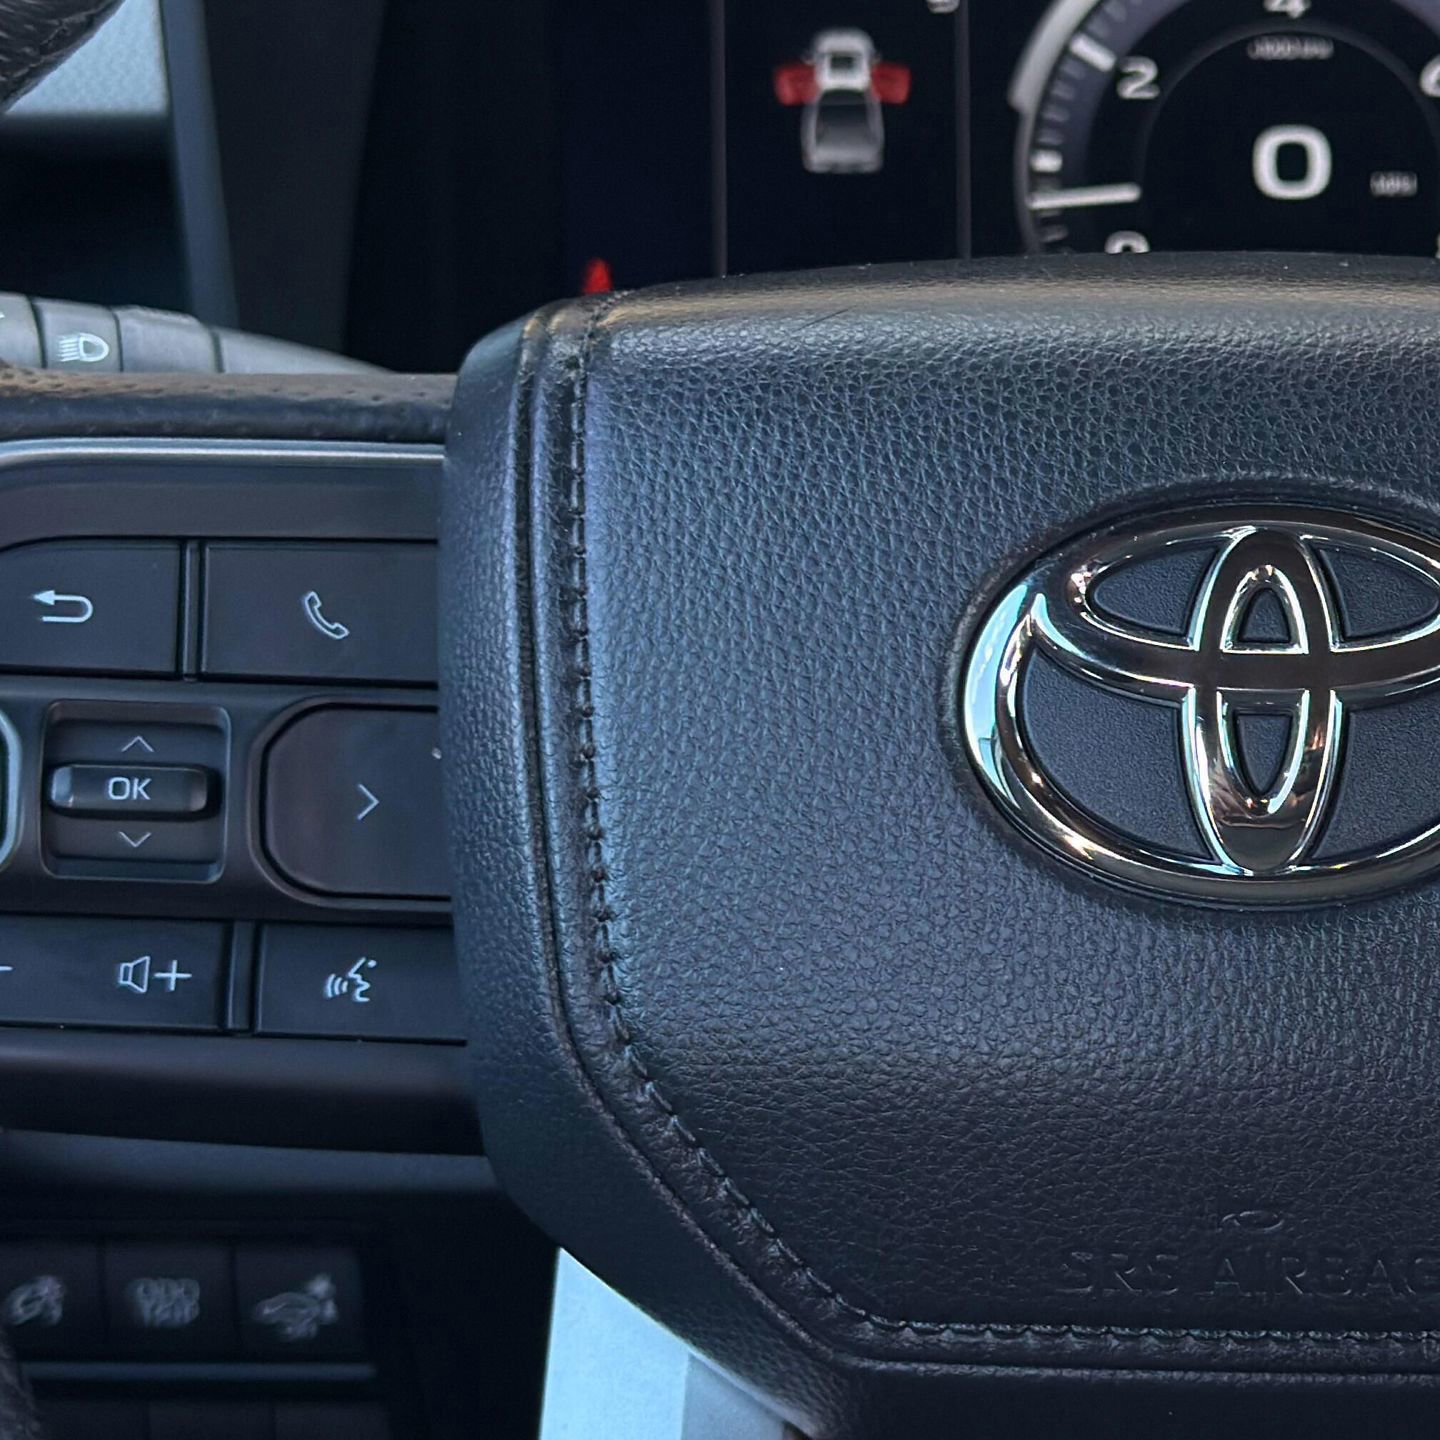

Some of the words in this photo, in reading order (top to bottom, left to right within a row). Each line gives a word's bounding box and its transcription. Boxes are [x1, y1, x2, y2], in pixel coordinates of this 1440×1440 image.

[1117, 56, 1160, 100] 2
[1252, 124, 1332, 200] 0
[106, 777, 152, 802] OK
